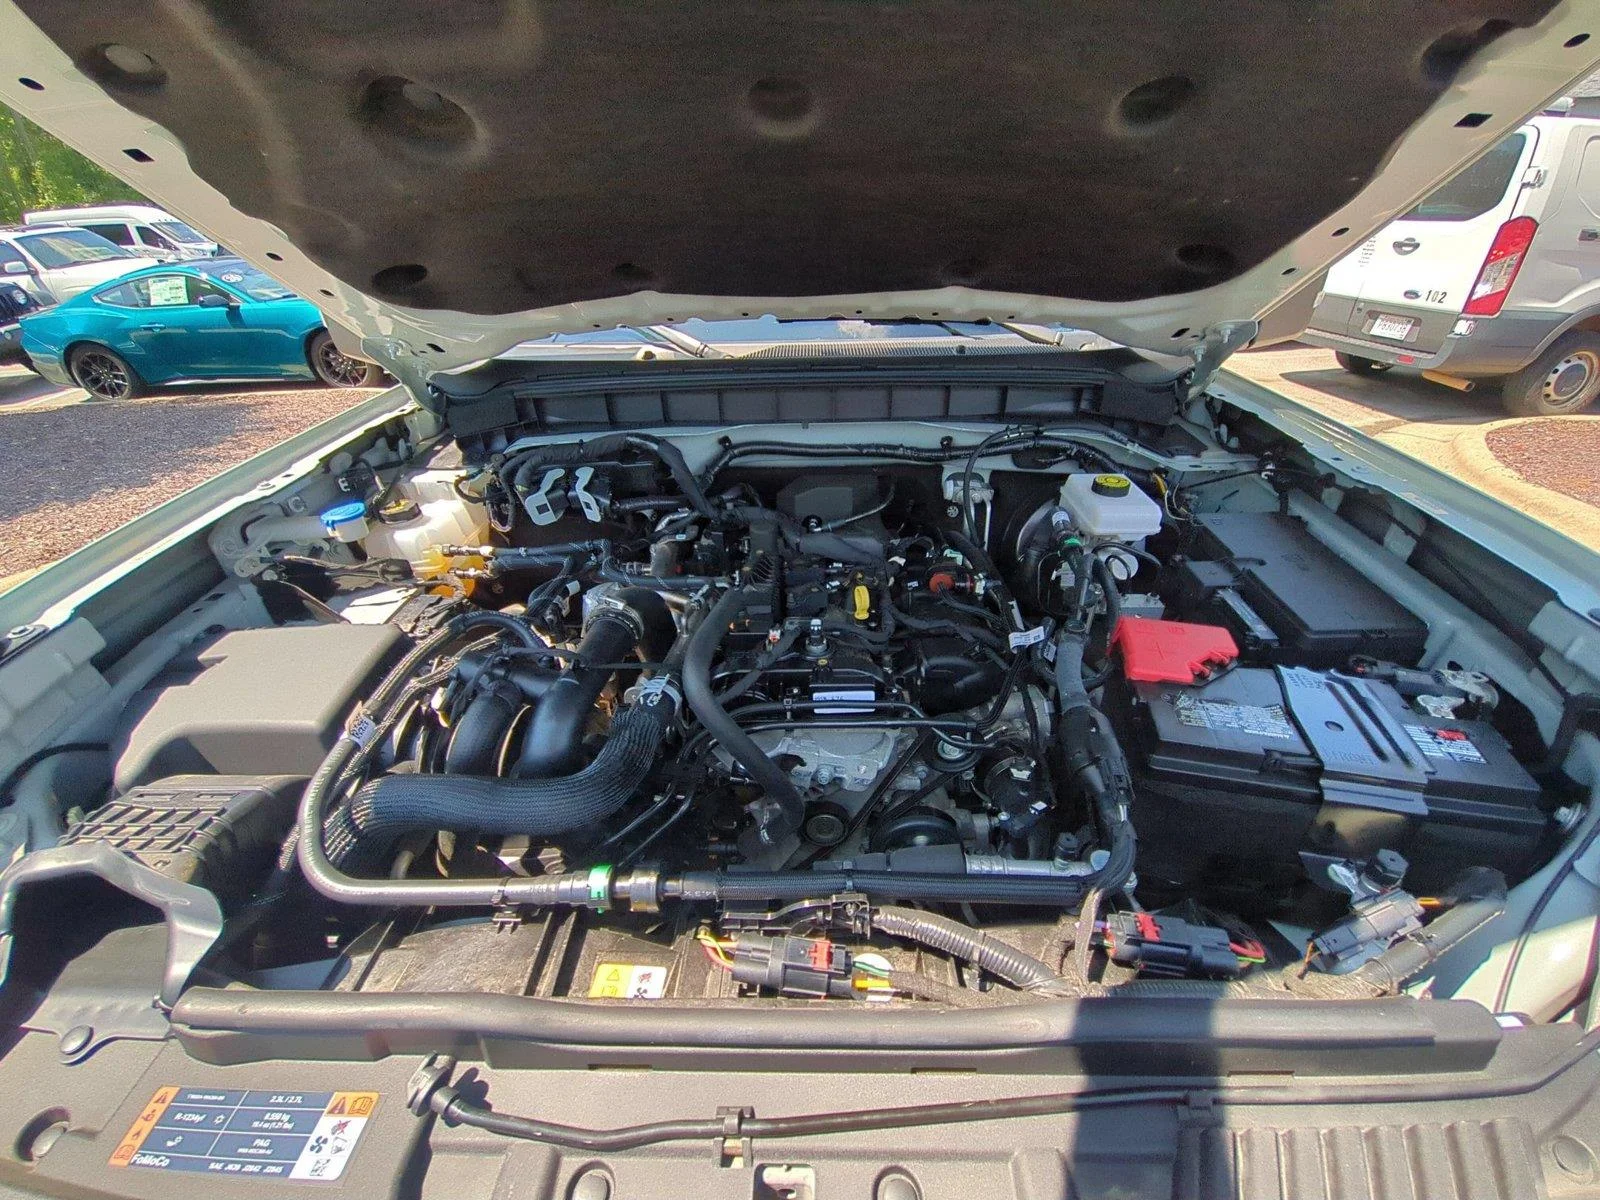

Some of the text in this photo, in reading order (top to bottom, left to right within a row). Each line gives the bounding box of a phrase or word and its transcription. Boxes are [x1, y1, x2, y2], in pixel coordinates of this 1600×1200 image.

[1426, 290, 1447, 303] 102
[253, 1138, 272, 1148] PAG
[130, 1153, 171, 1168] FoMoCo
